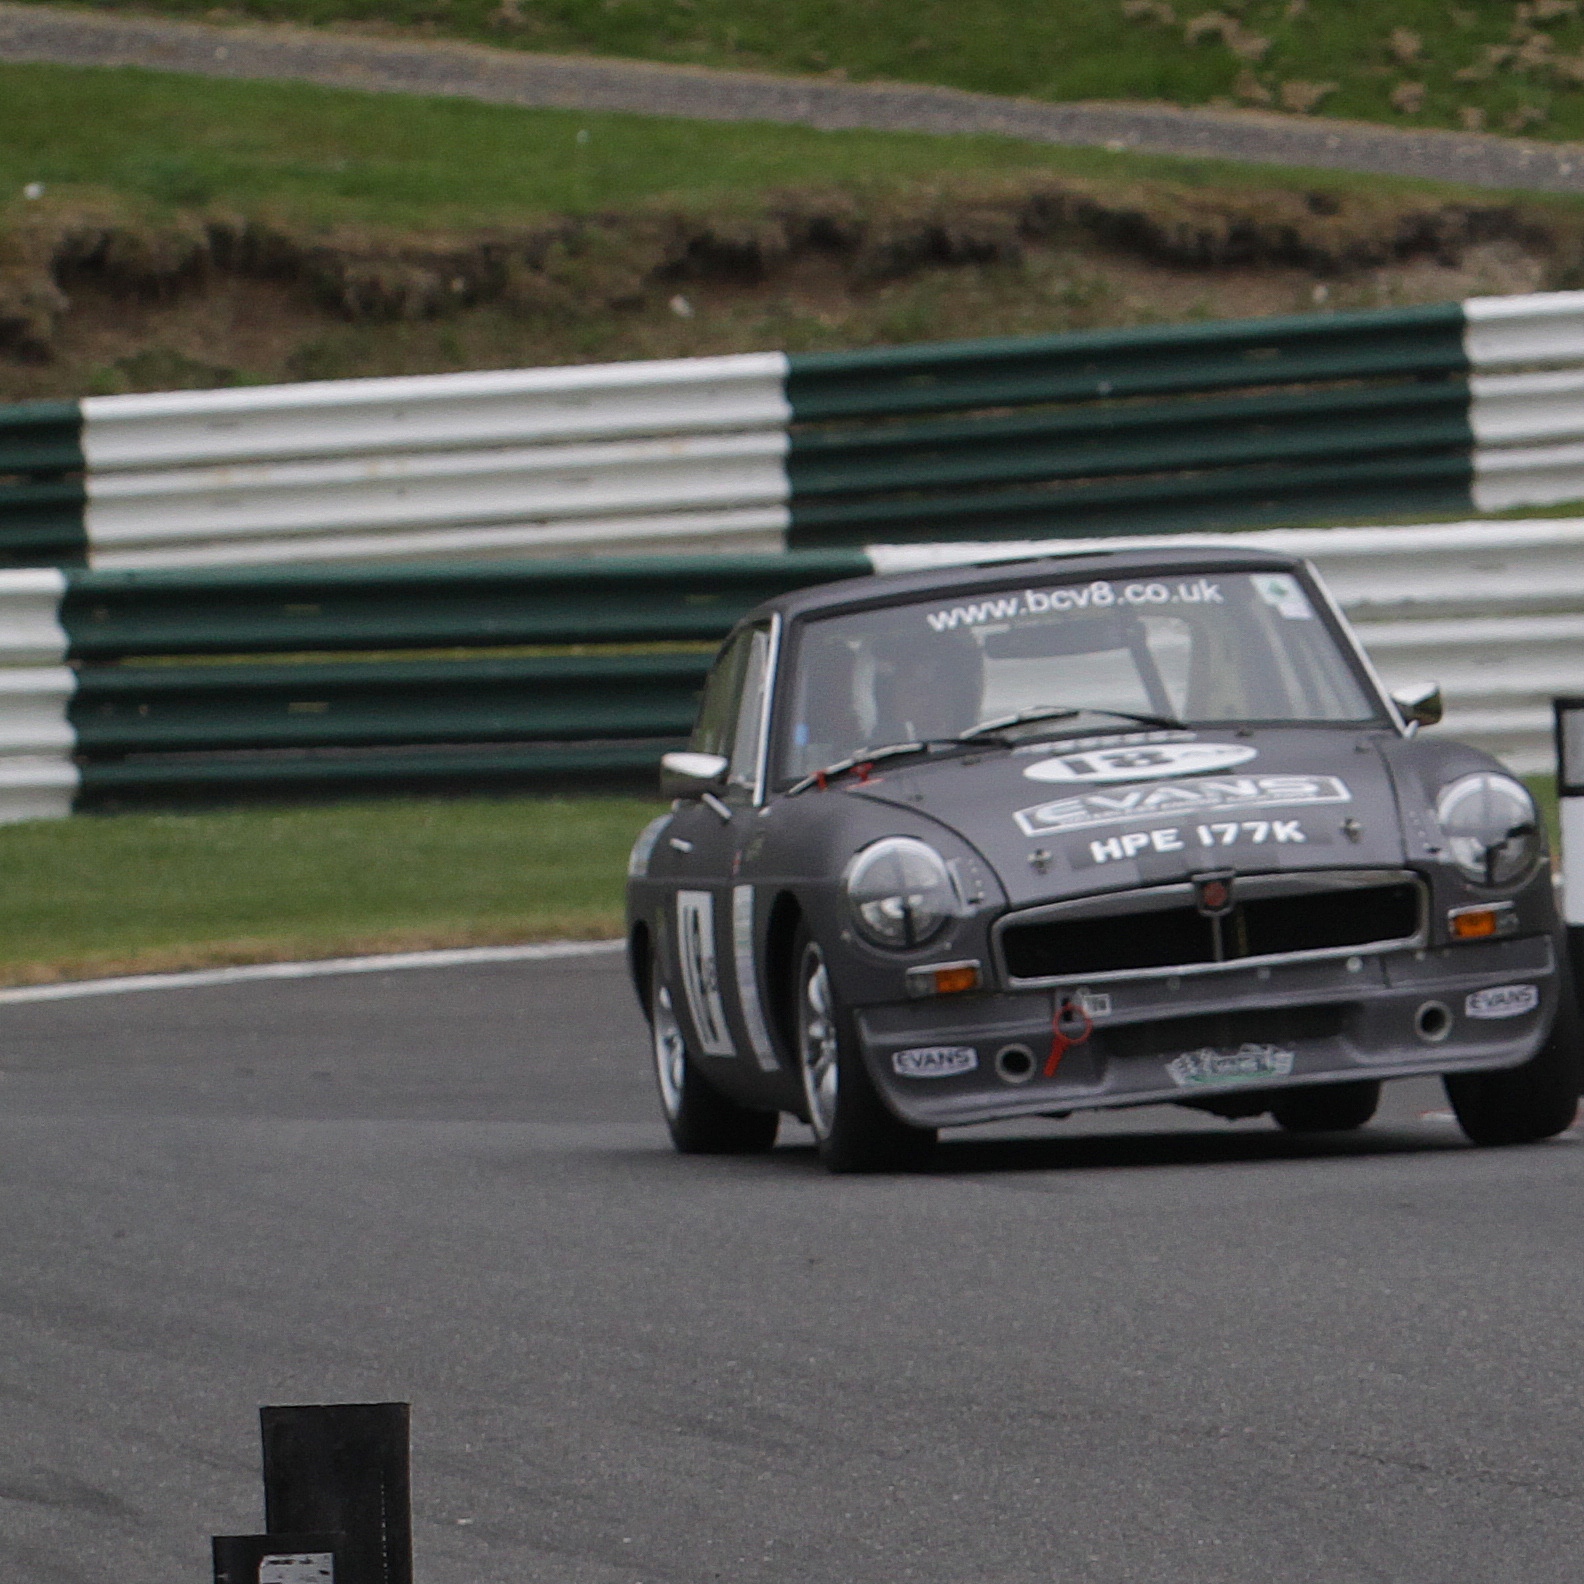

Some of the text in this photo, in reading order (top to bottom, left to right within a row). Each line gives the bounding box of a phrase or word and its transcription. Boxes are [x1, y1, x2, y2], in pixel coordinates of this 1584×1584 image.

[926, 578, 1224, 632] www.bcv8.co.uk
[1035, 775, 1320, 824] EVANS
[1090, 819, 1306, 863] HPE 177K
[896, 1050, 971, 1070] EVANS
